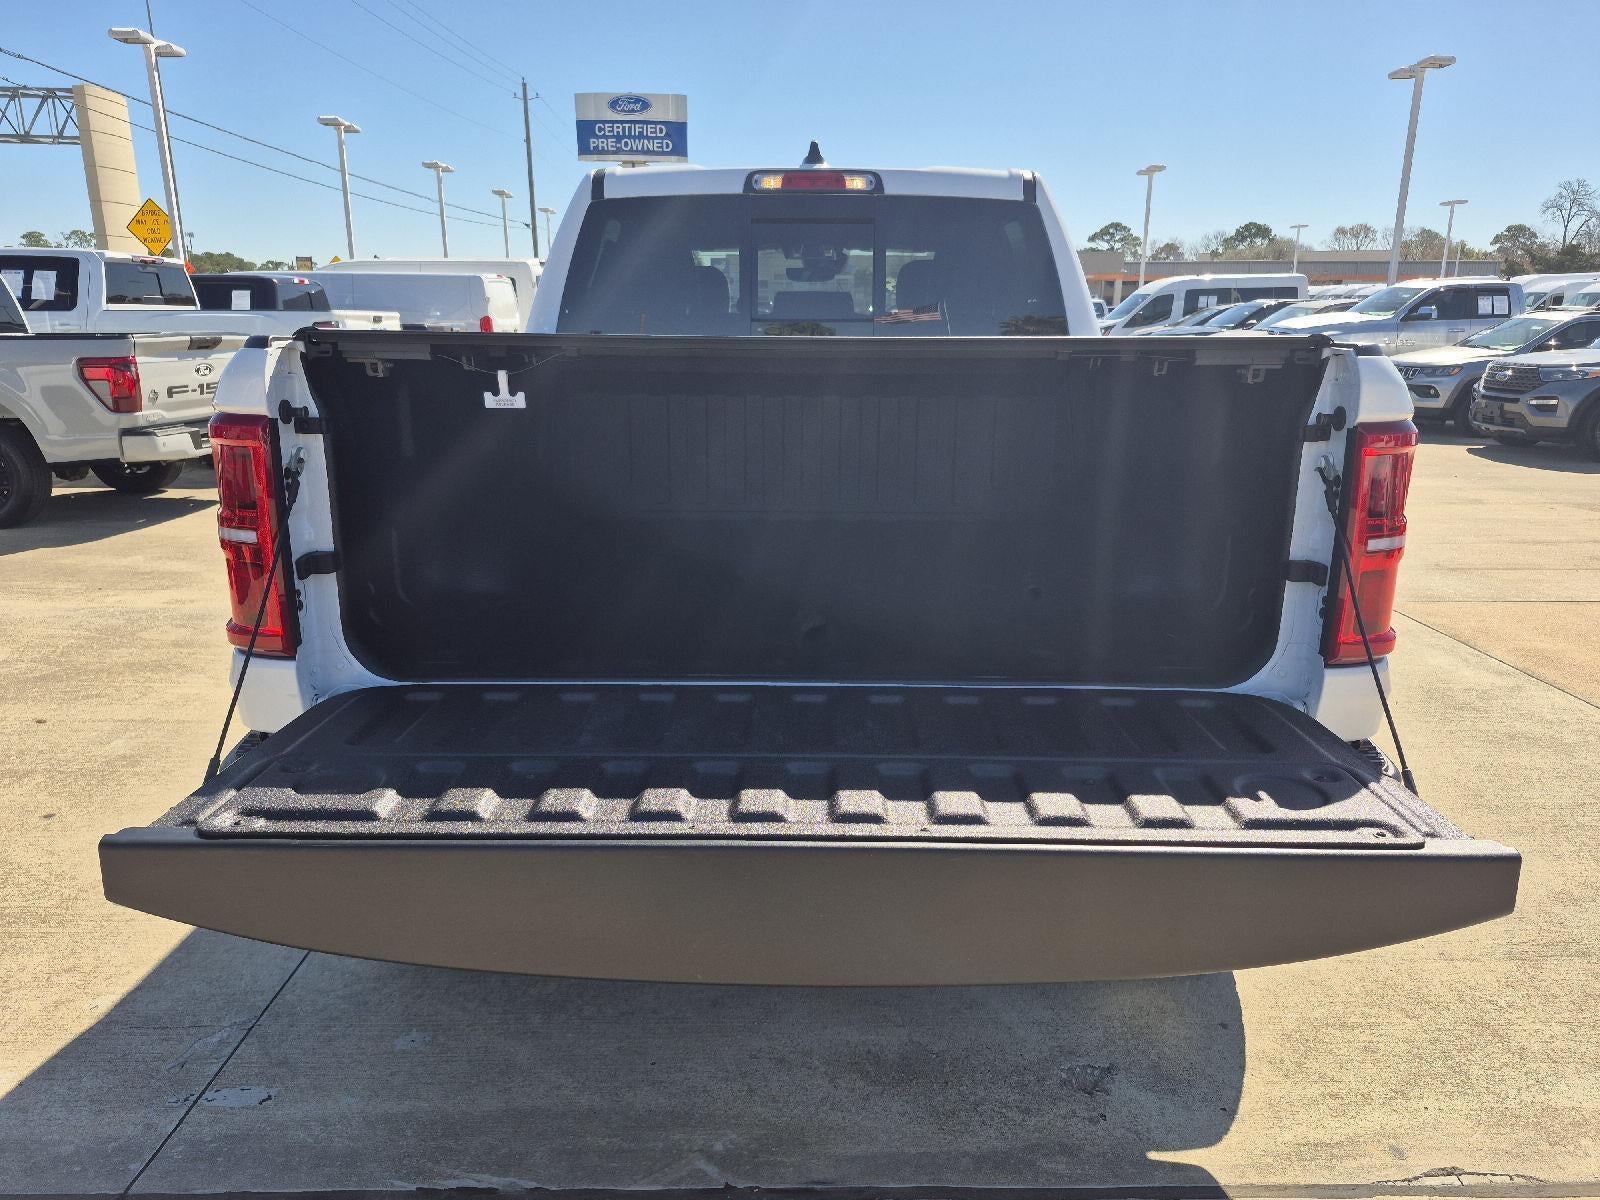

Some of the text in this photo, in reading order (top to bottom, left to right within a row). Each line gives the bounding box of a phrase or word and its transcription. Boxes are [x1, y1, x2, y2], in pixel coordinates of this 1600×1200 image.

[616, 98, 642, 111] Ford
[595, 123, 667, 137] CERTIFIED
[590, 138, 673, 152] PRE-OWNED
